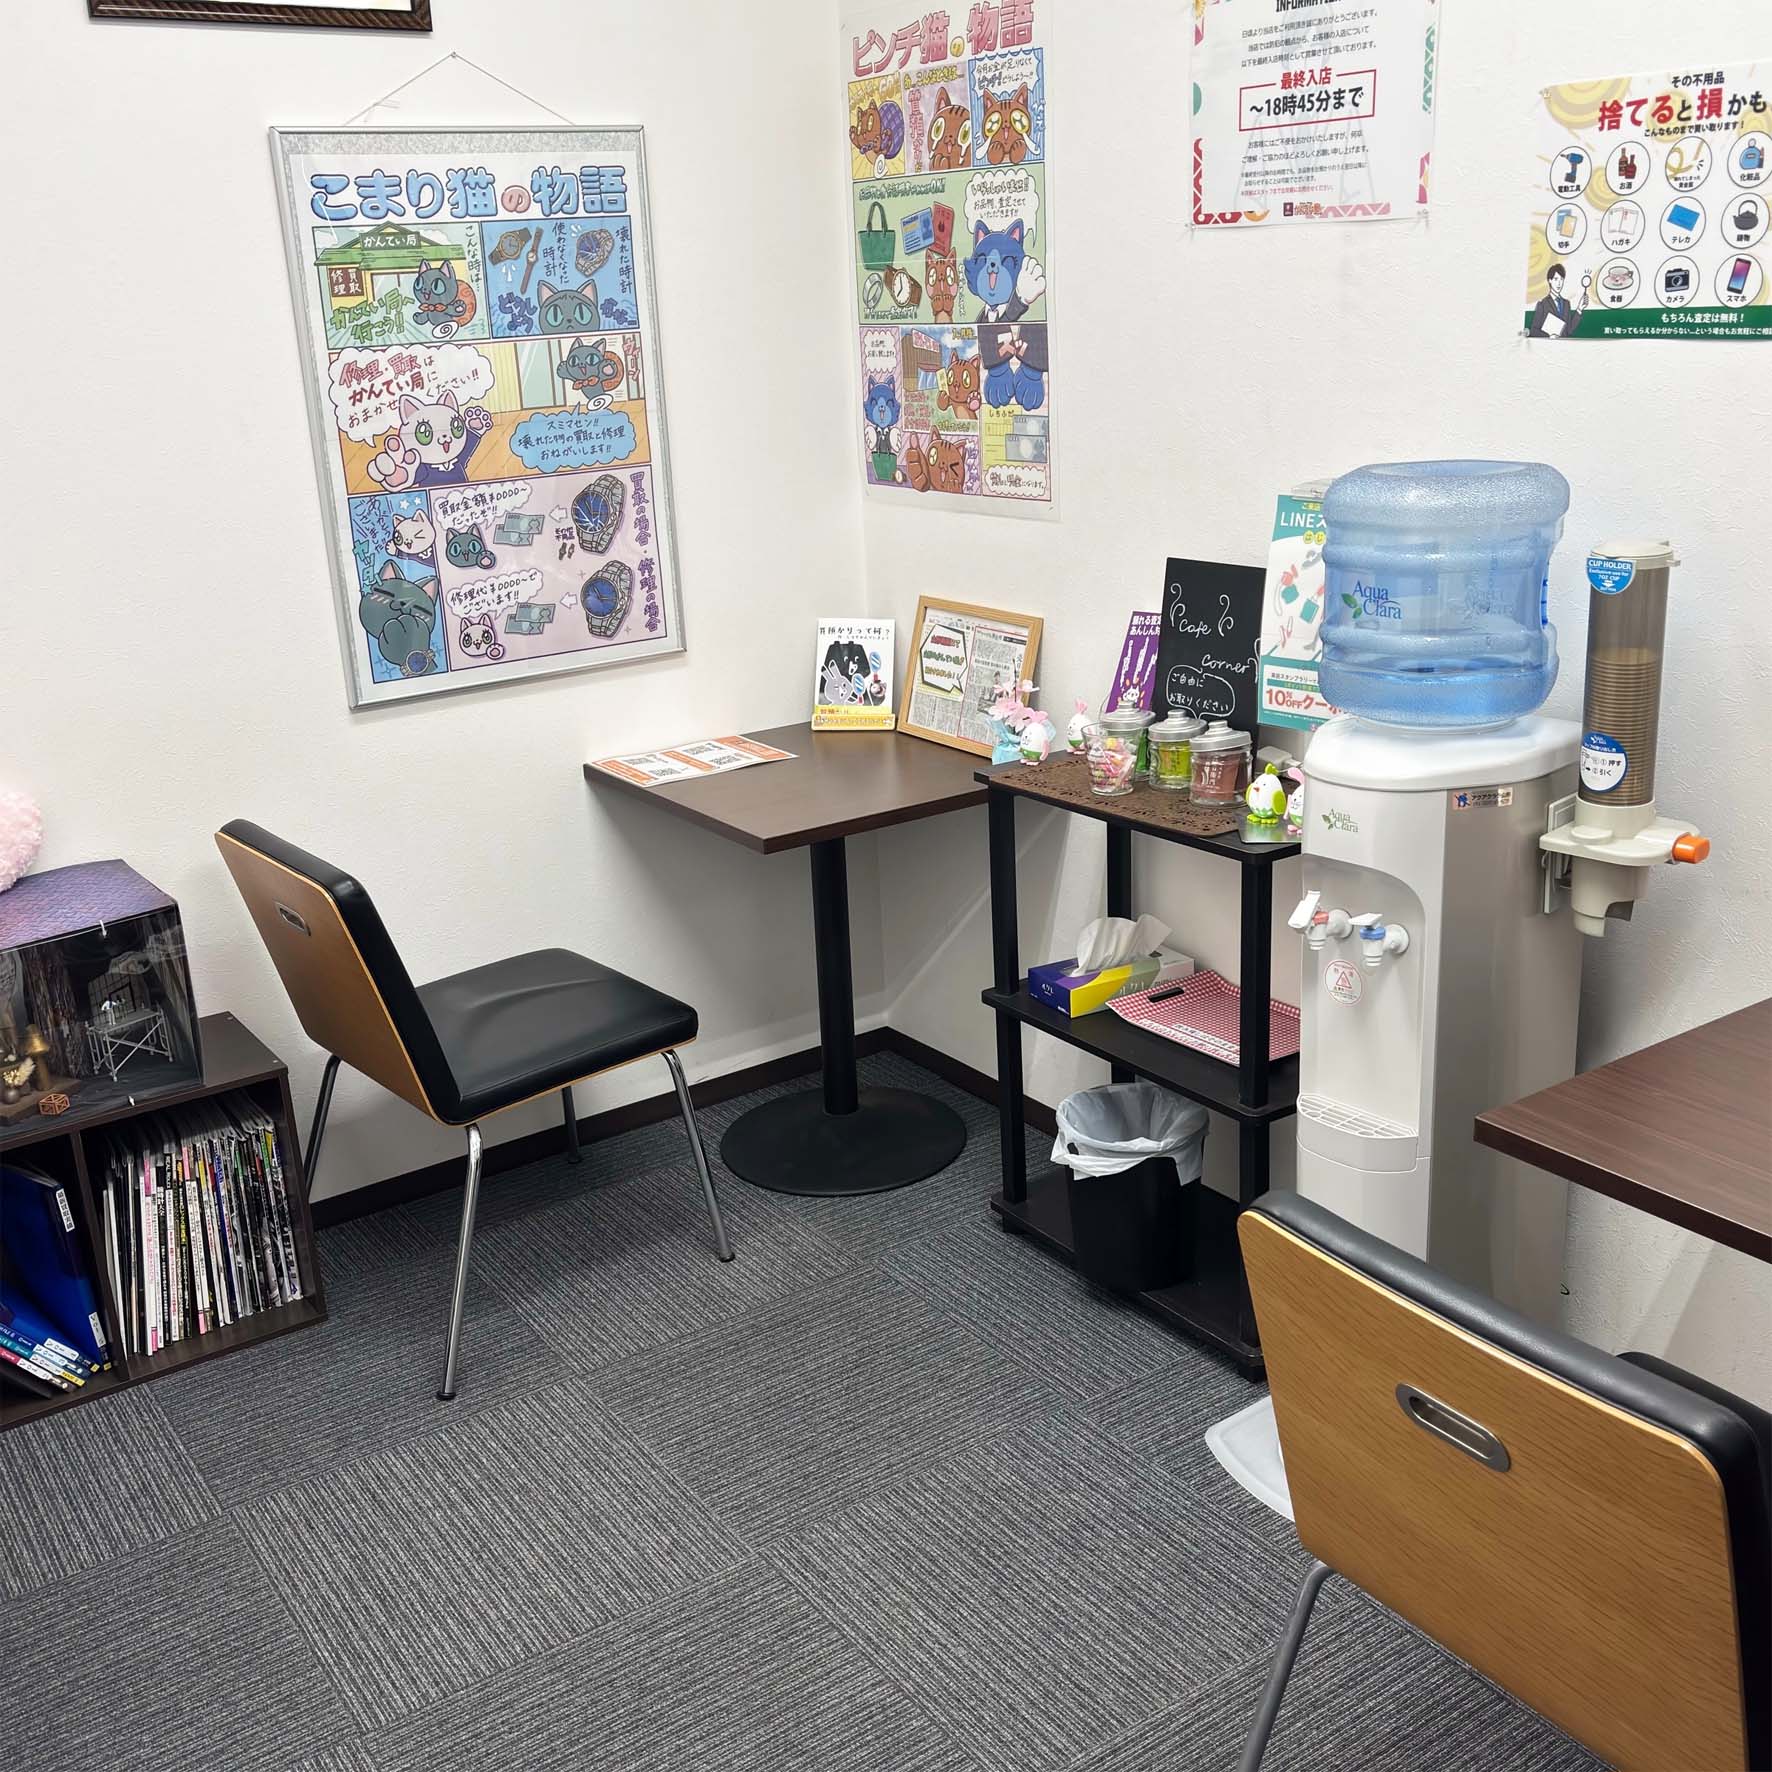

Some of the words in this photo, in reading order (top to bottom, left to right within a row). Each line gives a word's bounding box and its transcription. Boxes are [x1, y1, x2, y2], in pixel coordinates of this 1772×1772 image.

[1280, 66, 1332, 90] 最終入店
[1671, 71, 1725, 89] その不用品
[1598, 87, 1768, 132] 捨てると損かも
[1739, 172, 1761, 182] 化粧品
[310, 165, 629, 223] こまり猫の物語
[363, 235, 418, 248] かんてい局
[1611, 237, 1632, 247] ハガキ
[1671, 235, 1692, 246] テレカ
[543, 247, 558, 277] 時計
[615, 225, 634, 295] 壊れた時計
[1665, 294, 1686, 304] カメラ
[1726, 294, 1747, 304] スマホ
[329, 287, 416, 331] かんてい局へ
[1588, 560, 1603, 568] CUP
[1603, 561, 1632, 571] HOLDER
[1353, 580, 1389, 602] Aqua
[1363, 598, 1402, 620] Clara
[1178, 618, 1212, 640] Cafe
[1170, 672, 1205, 689] ご自由に
[1168, 691, 1230, 713] お取りください
[1329, 807, 1351, 822] Aqua
[1334, 819, 1359, 833] Clara
